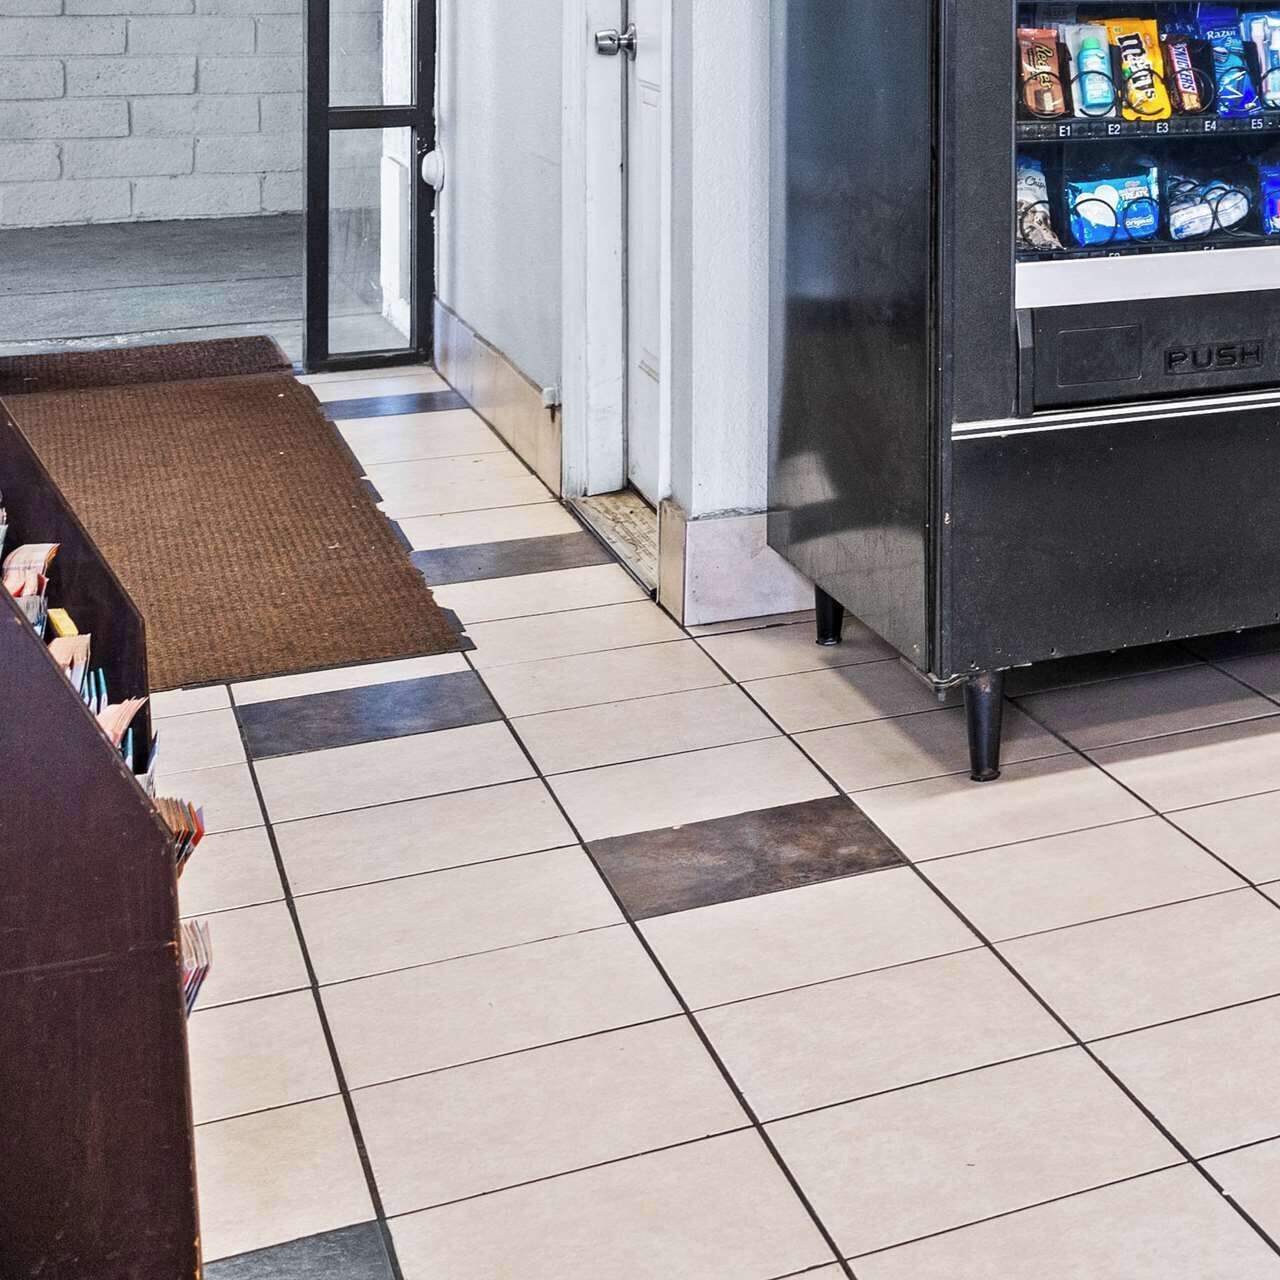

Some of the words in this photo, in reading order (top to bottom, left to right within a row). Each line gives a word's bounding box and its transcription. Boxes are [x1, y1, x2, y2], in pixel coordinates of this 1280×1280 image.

[1173, 42, 1197, 94] SNICKERS
[1156, 123, 1169, 133] E3
[1204, 121, 1216, 131] E4
[1251, 119, 1263, 129] E5
[1059, 126, 1071, 136] E1
[1108, 124, 1121, 135] E2
[1167, 344, 1263, 370] PUSH
